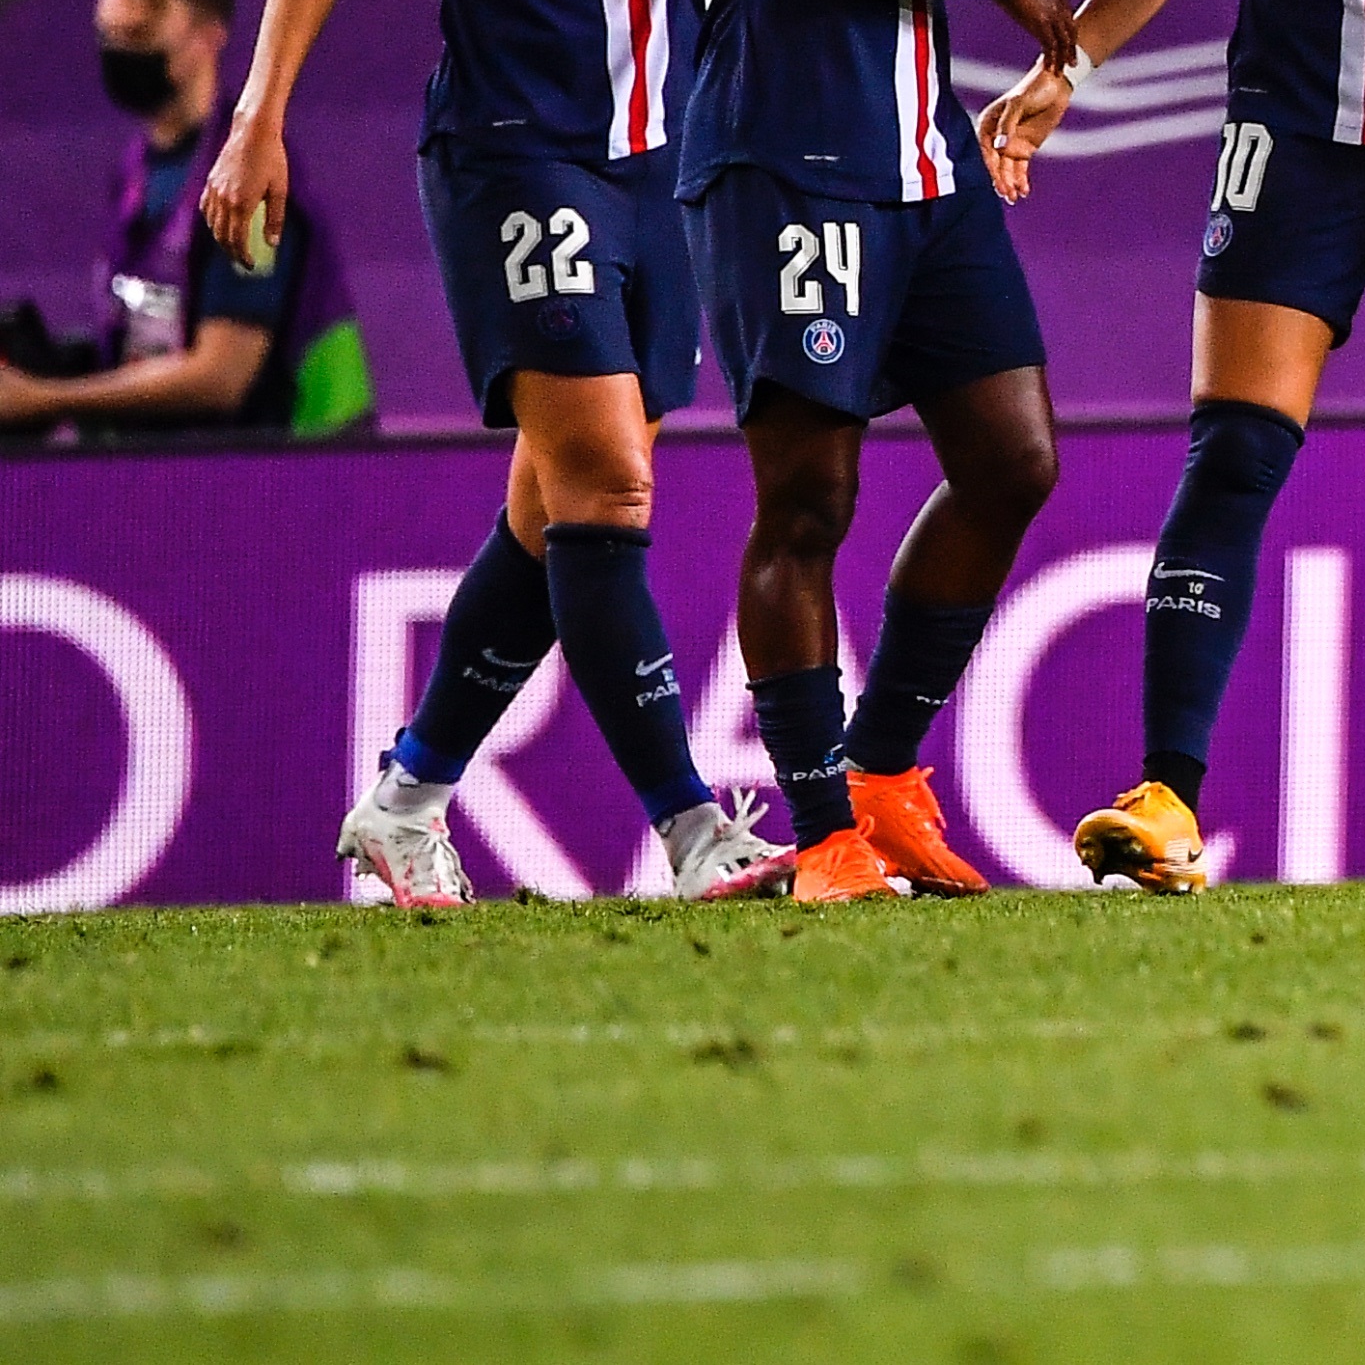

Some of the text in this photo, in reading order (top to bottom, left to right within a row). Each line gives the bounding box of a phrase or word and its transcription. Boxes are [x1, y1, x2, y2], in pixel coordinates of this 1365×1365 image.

[1211, 122, 1274, 212] 10
[501, 208, 596, 303] 22
[778, 222, 860, 316] 24
[1146, 595, 1222, 619] PARIS
[636, 681, 682, 708] PAR
